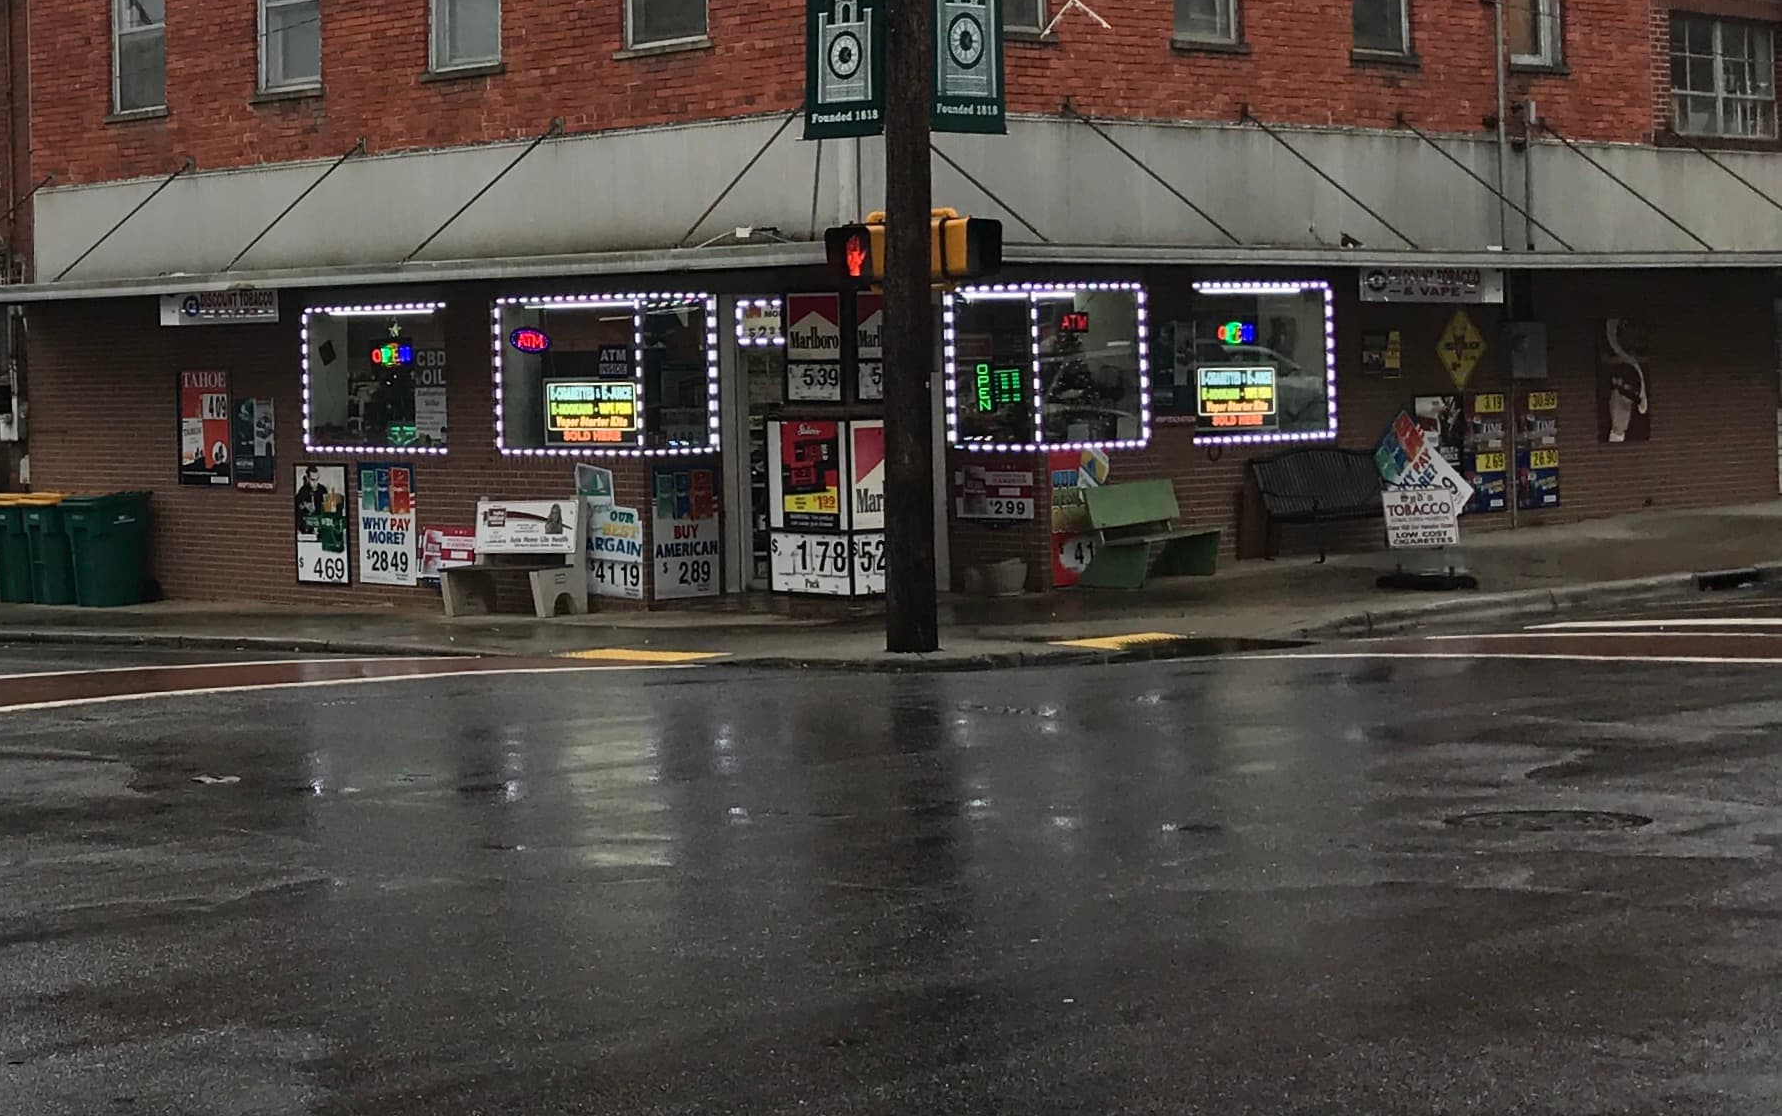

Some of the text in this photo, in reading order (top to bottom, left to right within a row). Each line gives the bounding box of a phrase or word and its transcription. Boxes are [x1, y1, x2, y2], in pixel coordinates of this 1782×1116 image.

[936, 102, 999, 116] Founded 1818
[811, 111, 853, 125] Founded
[1420, 286, 1461, 297] VAPE
[1060, 313, 1088, 330] ATM
[517, 332, 545, 349] ATM
[789, 326, 839, 350] Marlboro
[417, 350, 447, 366] CBD
[600, 349, 627, 362] ATM
[183, 371, 227, 388] TAHOE
[422, 369, 447, 385] OIL
[976, 363, 992, 412] OPEN
[563, 430, 592, 442] SOLD
[1412, 447, 1432, 474] PAY
[609, 510, 635, 524] OUR
[1386, 502, 1451, 517] TOBACCO
[362, 516, 411, 532] WHY PAY
[673, 524, 699, 540] BUY
[368, 531, 406, 546] MORE?
[1395, 530, 1448, 539] LOW COST
[586, 537, 642, 558] ARGAIN
[655, 540, 718, 559] AMERICAN
